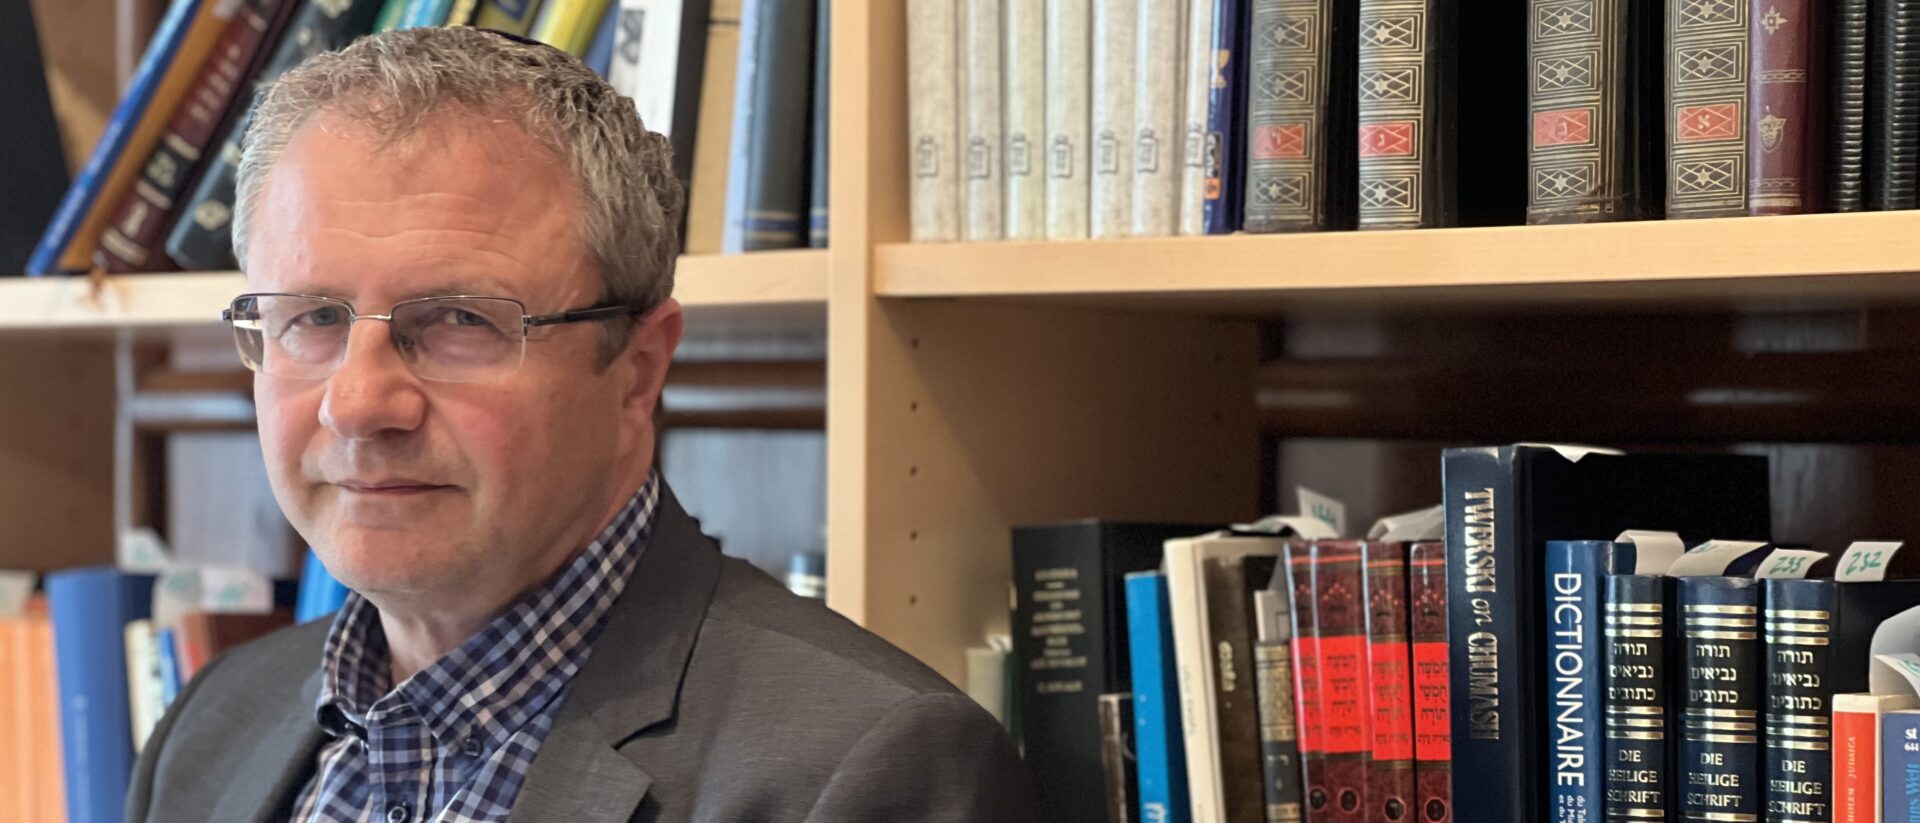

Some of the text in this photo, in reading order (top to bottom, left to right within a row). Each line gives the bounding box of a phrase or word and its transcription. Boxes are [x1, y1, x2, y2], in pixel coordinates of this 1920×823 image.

[1464, 487, 1500, 740] TWERSKI on CHUMASH
[1613, 642, 1648, 656] תורה
[1695, 644, 1731, 658] תורה
[1777, 649, 1814, 664] תורה
[1608, 664, 1655, 679] נביאים
[1690, 666, 1737, 681] נביאים
[1553, 572, 1585, 787] DICTIONNAIRE
[1771, 672, 1820, 688] נביאים
[1608, 686, 1656, 701] כתובים
[1689, 688, 1739, 704] כתובים
[1771, 695, 1822, 710] כתובים
[1618, 749, 1642, 762] DIE
[1700, 752, 1724, 766] DIE
[1847, 736, 1857, 779] JUDAICA
[1781, 759, 1806, 774] DIE
[1608, 769, 1658, 783] HEILIGE
[1688, 772, 1740, 787] HEILIGE
[1769, 779, 1823, 795] HEILIGE
[1567, 795, 1575, 807] du
[1577, 795, 1586, 807] du
[1607, 789, 1661, 804] SCHRIFT
[1687, 792, 1742, 807] SCHRIFT
[1767, 800, 1826, 815] SCHRIFT
